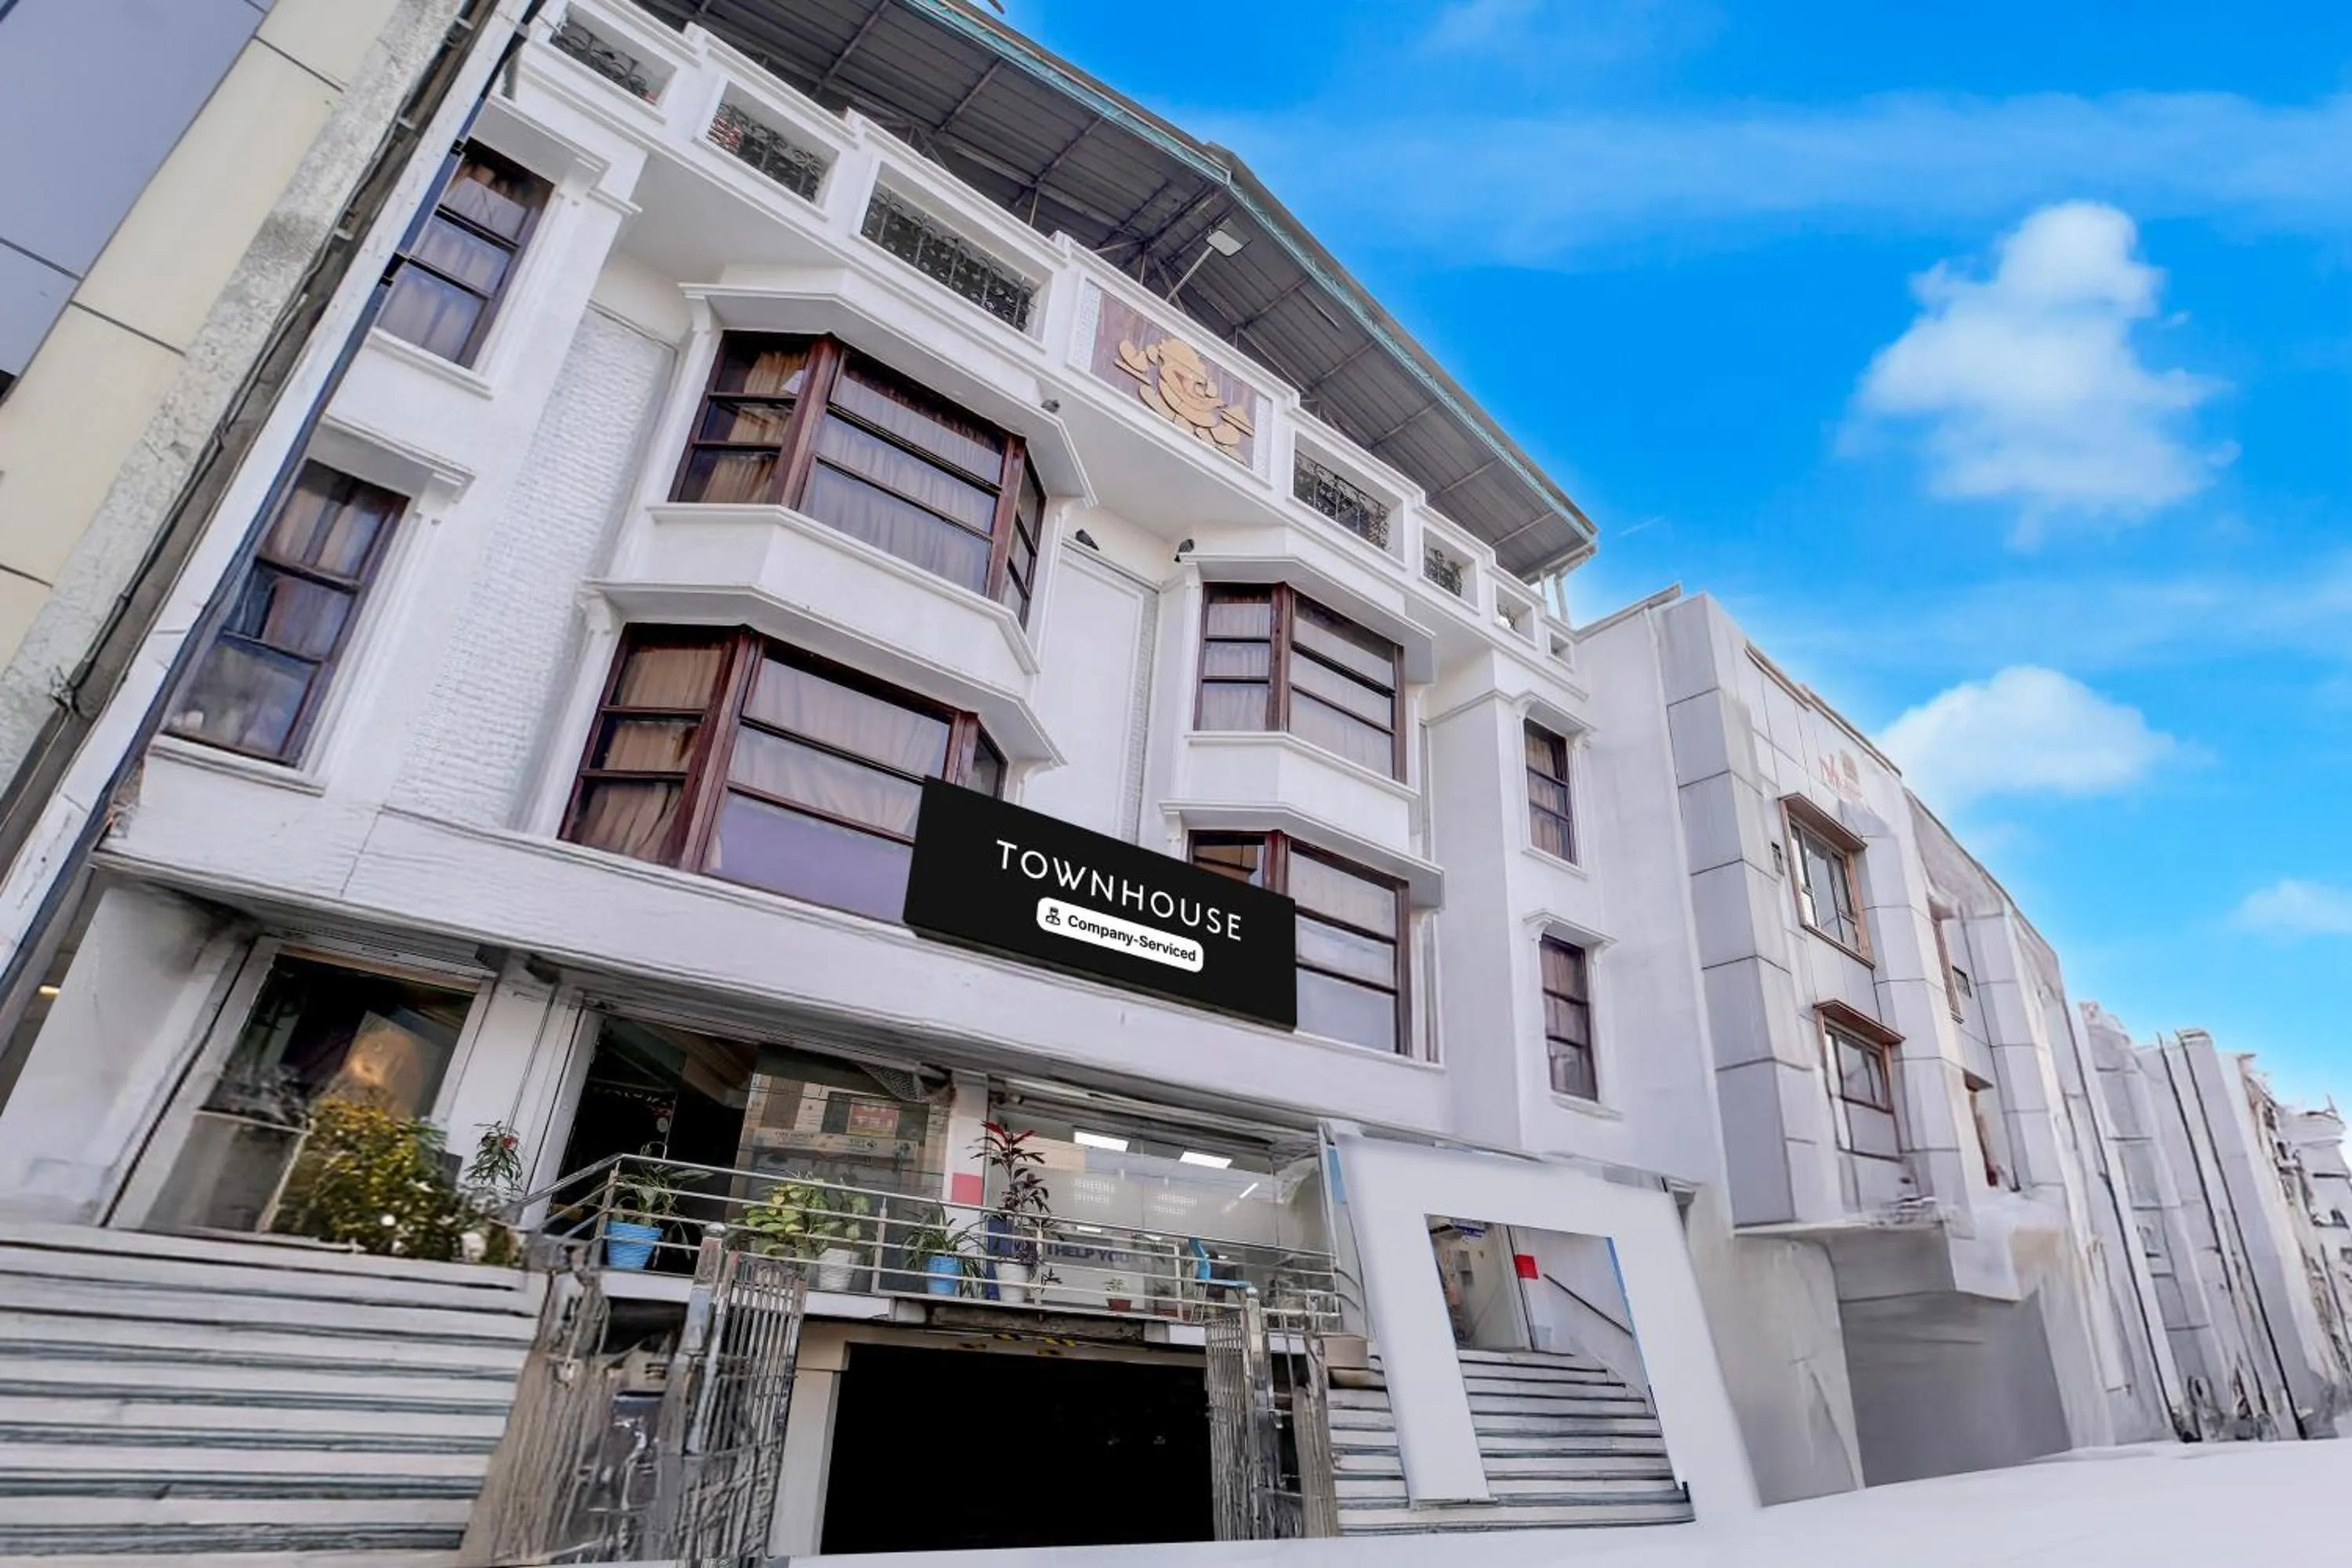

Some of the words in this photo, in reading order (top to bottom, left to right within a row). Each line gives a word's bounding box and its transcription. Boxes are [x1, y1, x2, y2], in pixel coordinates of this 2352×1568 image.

[996, 840, 1241, 942] TOWNHOUSE
[1068, 914, 1196, 962] Company-Serviced
[1055, 1244, 1095, 1259] HELP
[1097, 1248, 1129, 1263] YOU
